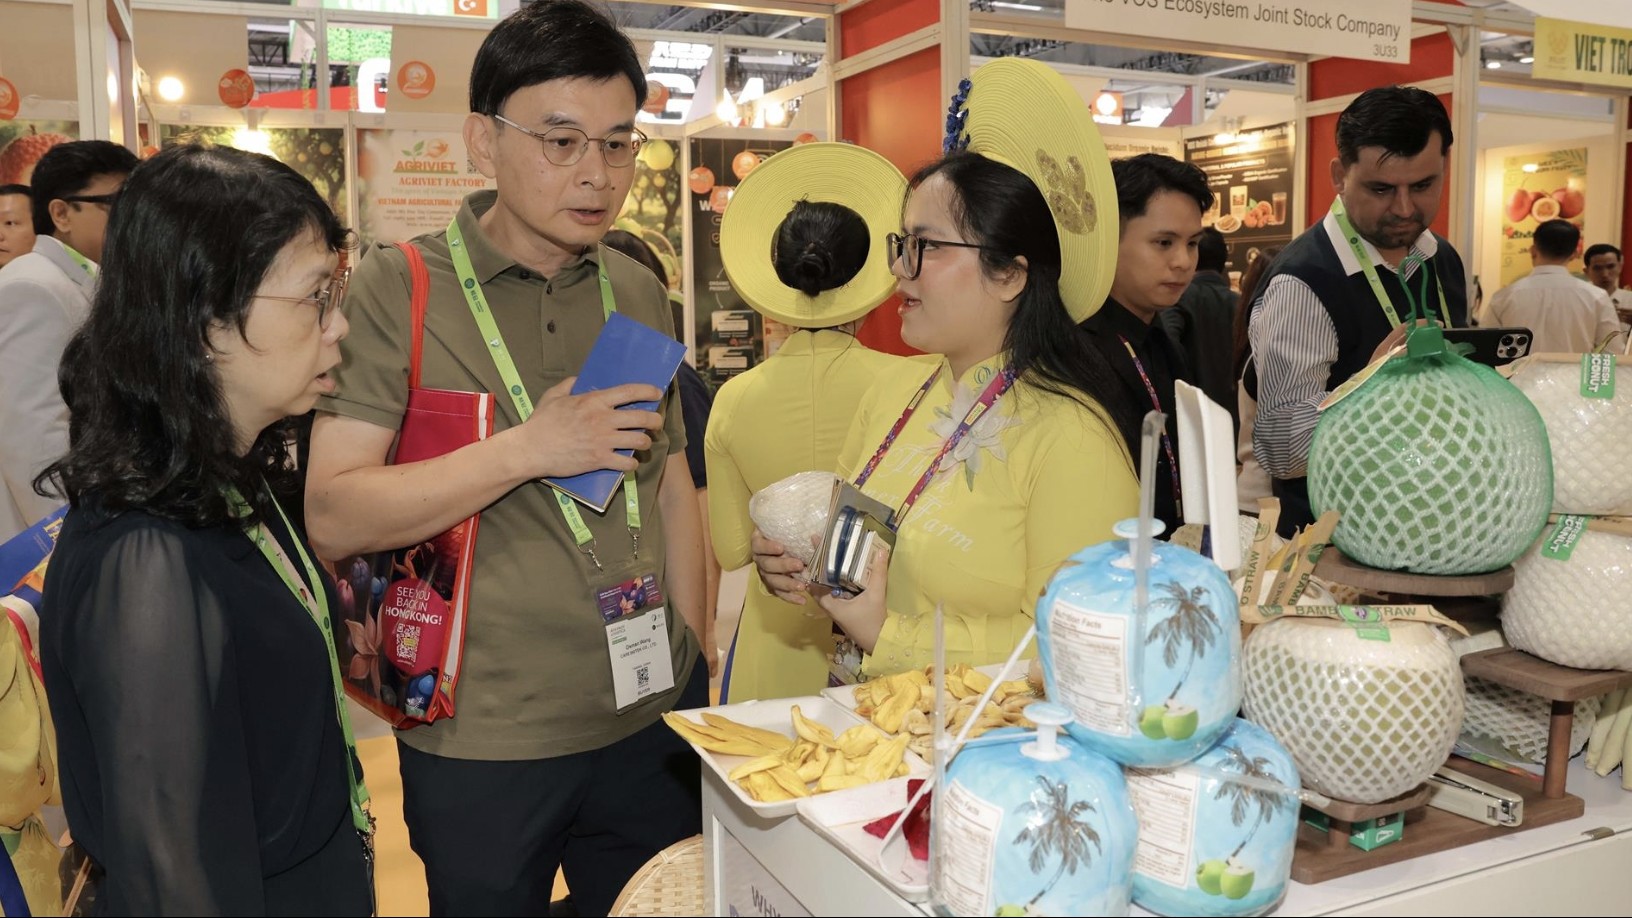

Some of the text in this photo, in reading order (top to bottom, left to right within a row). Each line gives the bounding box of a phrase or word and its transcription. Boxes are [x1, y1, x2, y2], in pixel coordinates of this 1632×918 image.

[1164, 0, 1401, 41] Ecosystem Joint Stock Company
[1373, 44, 1398, 58] 3U33
[1574, 33, 1606, 72] VIET
[395, 160, 456, 172] AGRIVIET
[399, 177, 487, 188] AGRIVIET FACTORY
[1243, 551, 1260, 593] STRAW
[396, 586, 431, 601] SEE YOU
[396, 597, 428, 612] BACK IN
[385, 605, 443, 626] HONG KONG!
